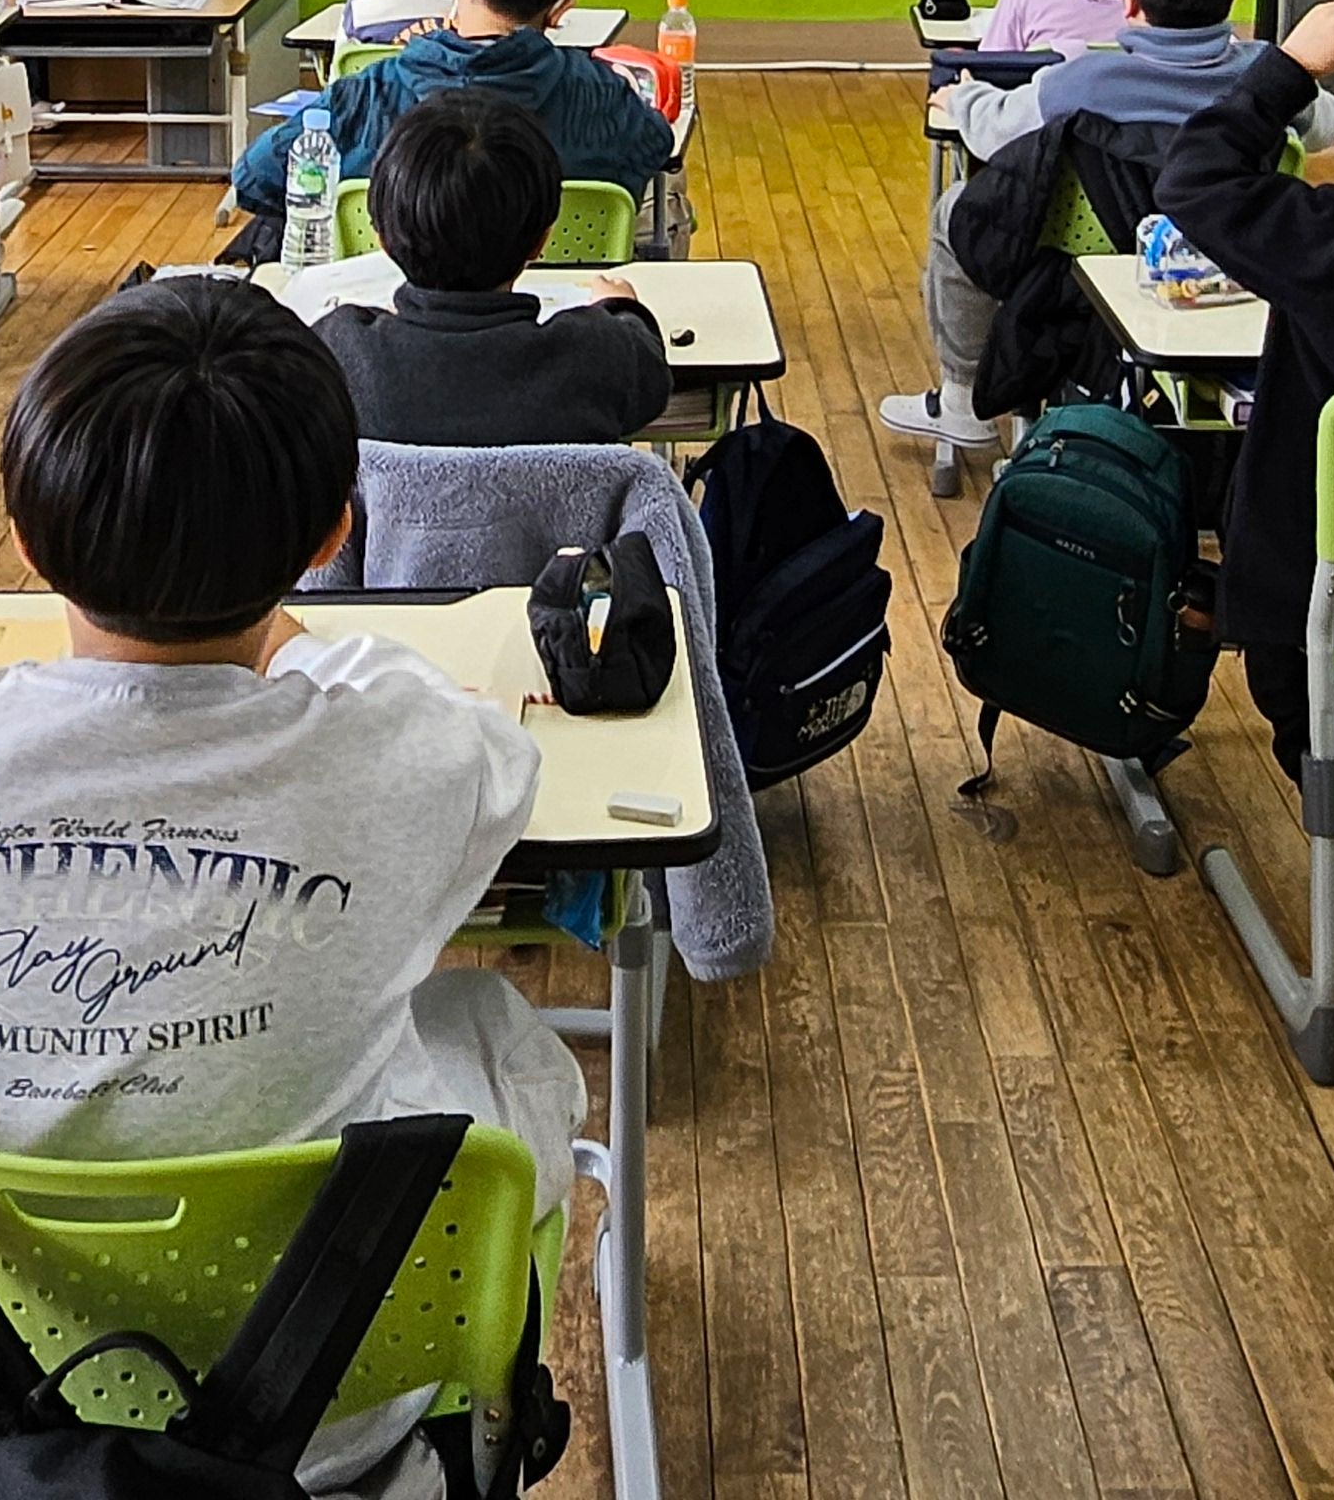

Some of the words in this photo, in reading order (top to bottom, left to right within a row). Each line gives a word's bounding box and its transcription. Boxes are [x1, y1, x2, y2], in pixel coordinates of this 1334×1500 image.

[67, 900, 258, 1025] Ground
[146, 1002, 274, 1051] SPIRIT
[118, 1073, 186, 1098] Club
